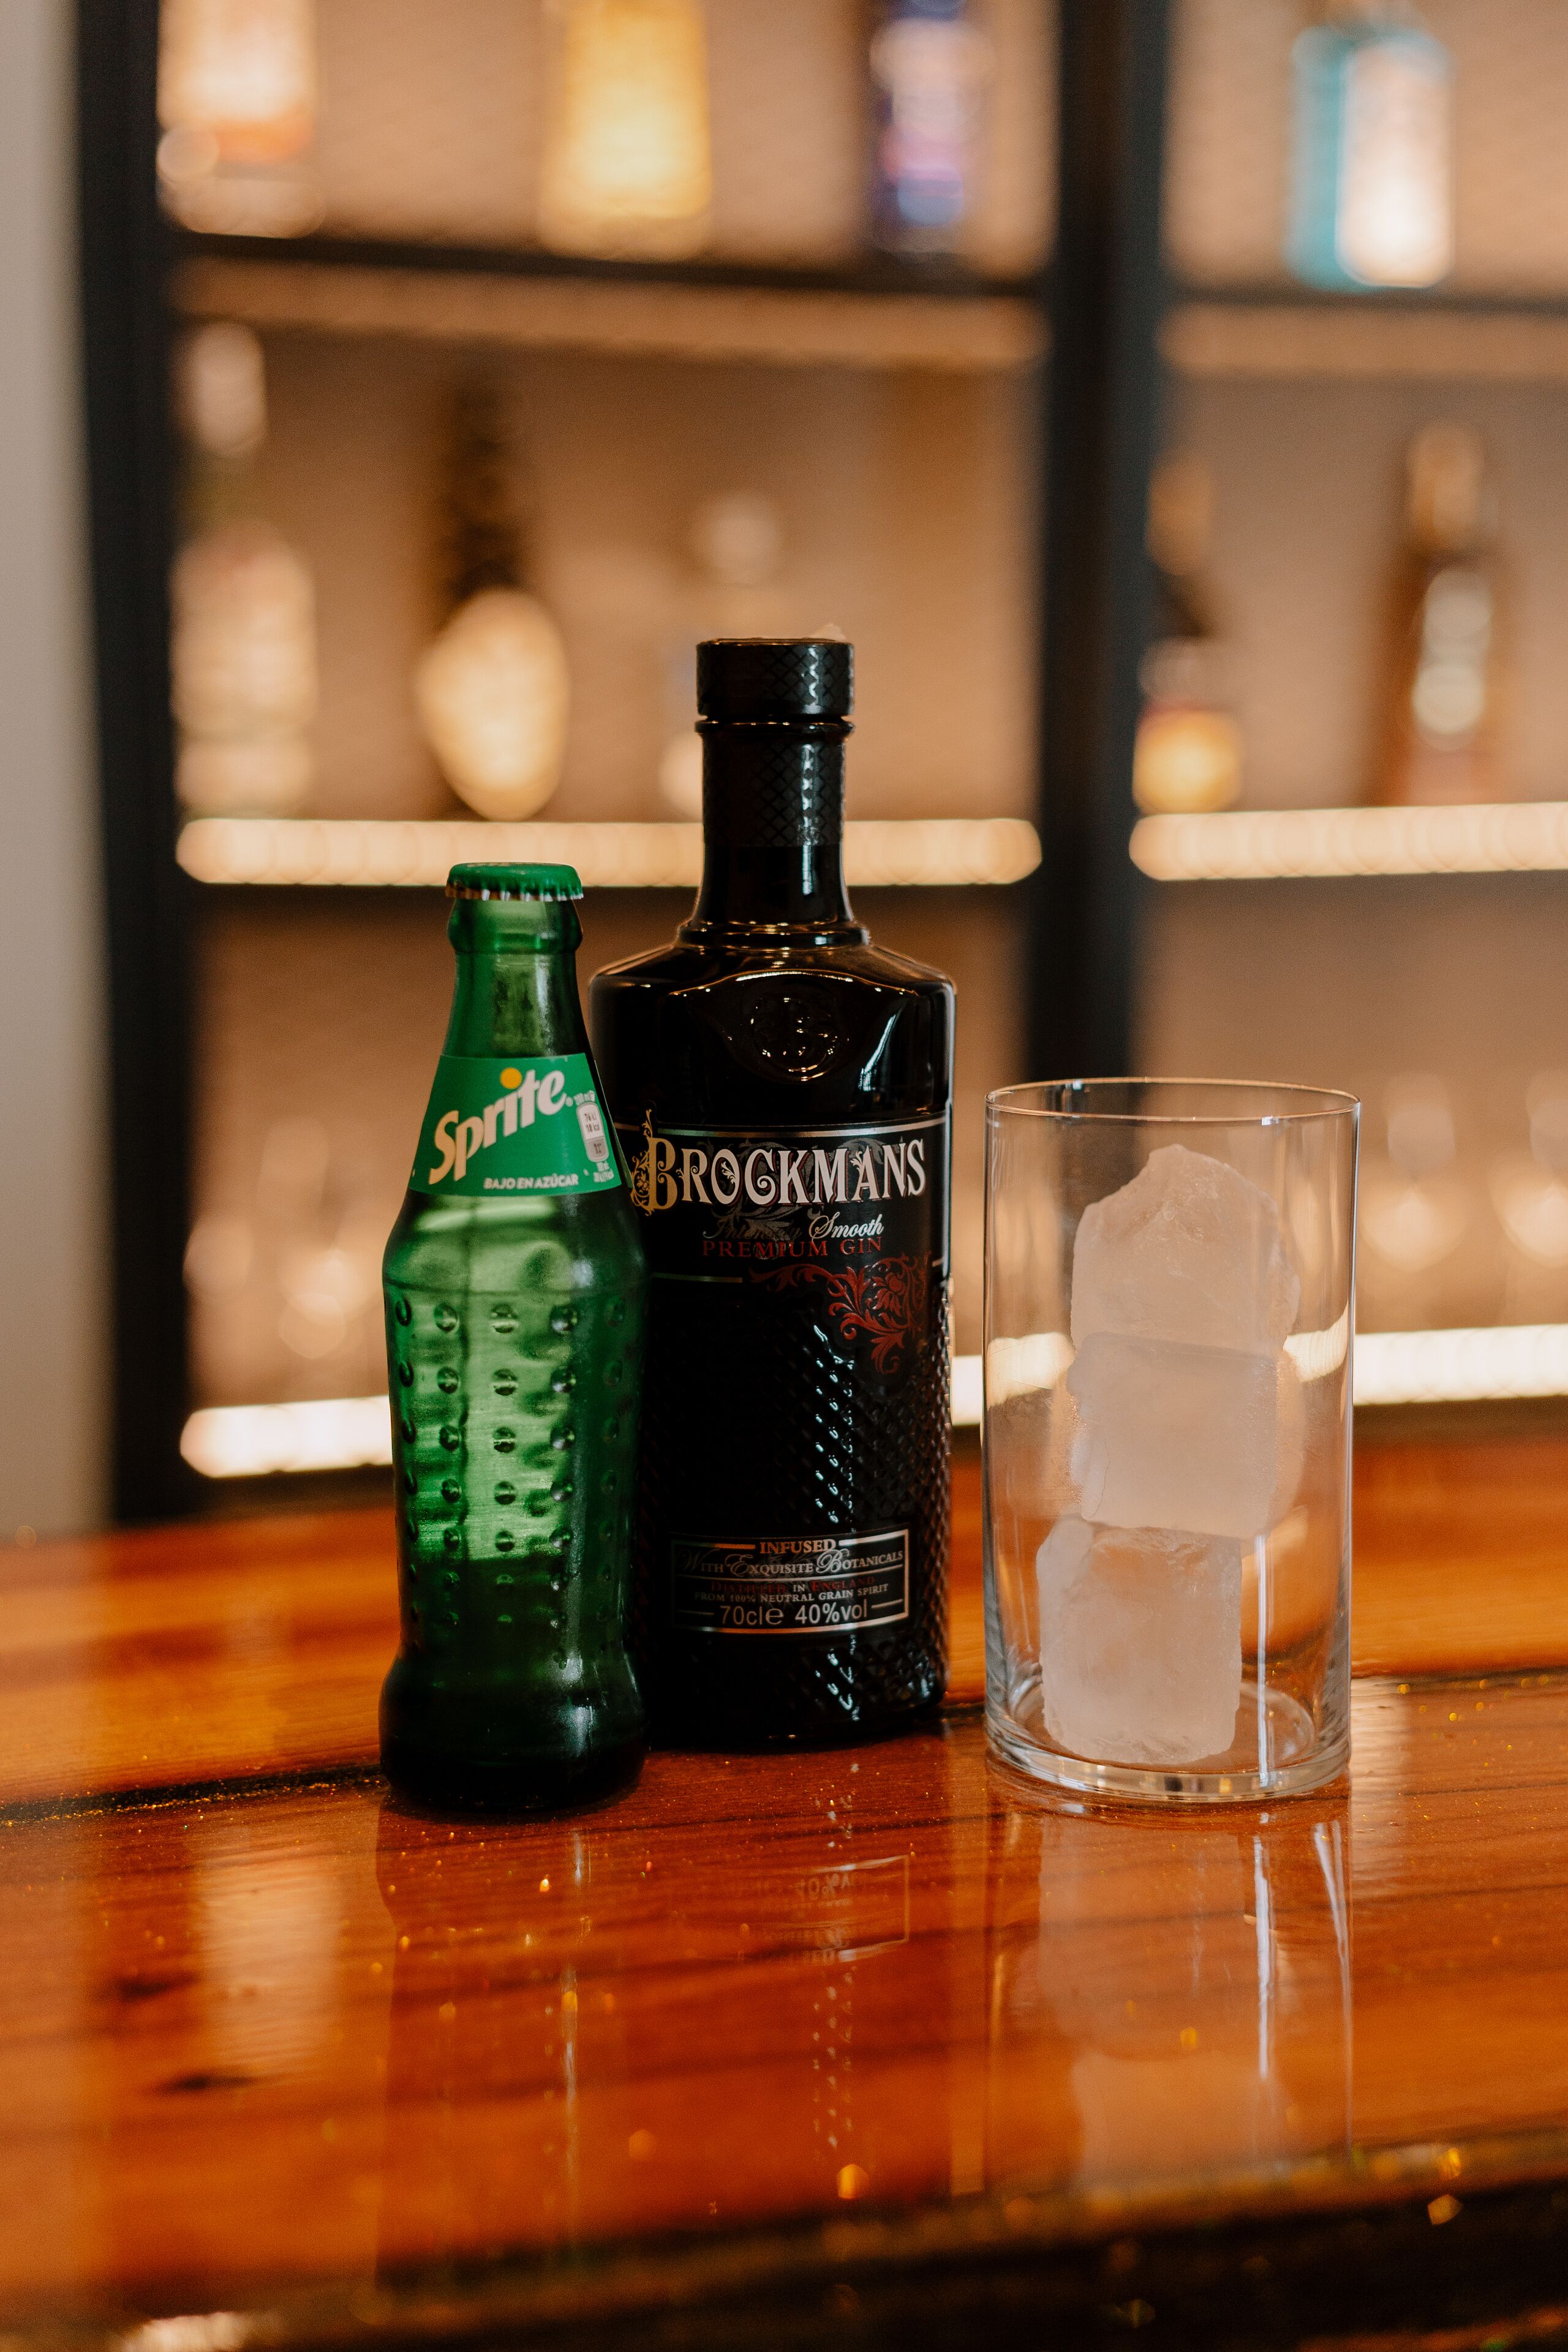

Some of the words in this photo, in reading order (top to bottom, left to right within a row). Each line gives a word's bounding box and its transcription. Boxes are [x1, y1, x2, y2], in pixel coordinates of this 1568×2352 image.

[429, 1067, 567, 1185] Sprite
[483, 1177, 516, 1190] BAJO
[516, 1177, 533, 1189] EN
[533, 1172, 579, 1189] AZÚCAR
[635, 1137, 925, 1213] BROCKMANS
[808, 1212, 884, 1241] Smooth
[701, 1239, 829, 1257] PREMIUM
[839, 1235, 883, 1255] GIN
[760, 1539, 837, 1555] INFUSED
[760, 1593, 815, 1603] NEUTRAL
[818, 1589, 853, 1601] GRAIN
[856, 1583, 889, 1597] SPIRIT
[792, 1584, 806, 1593] IN
